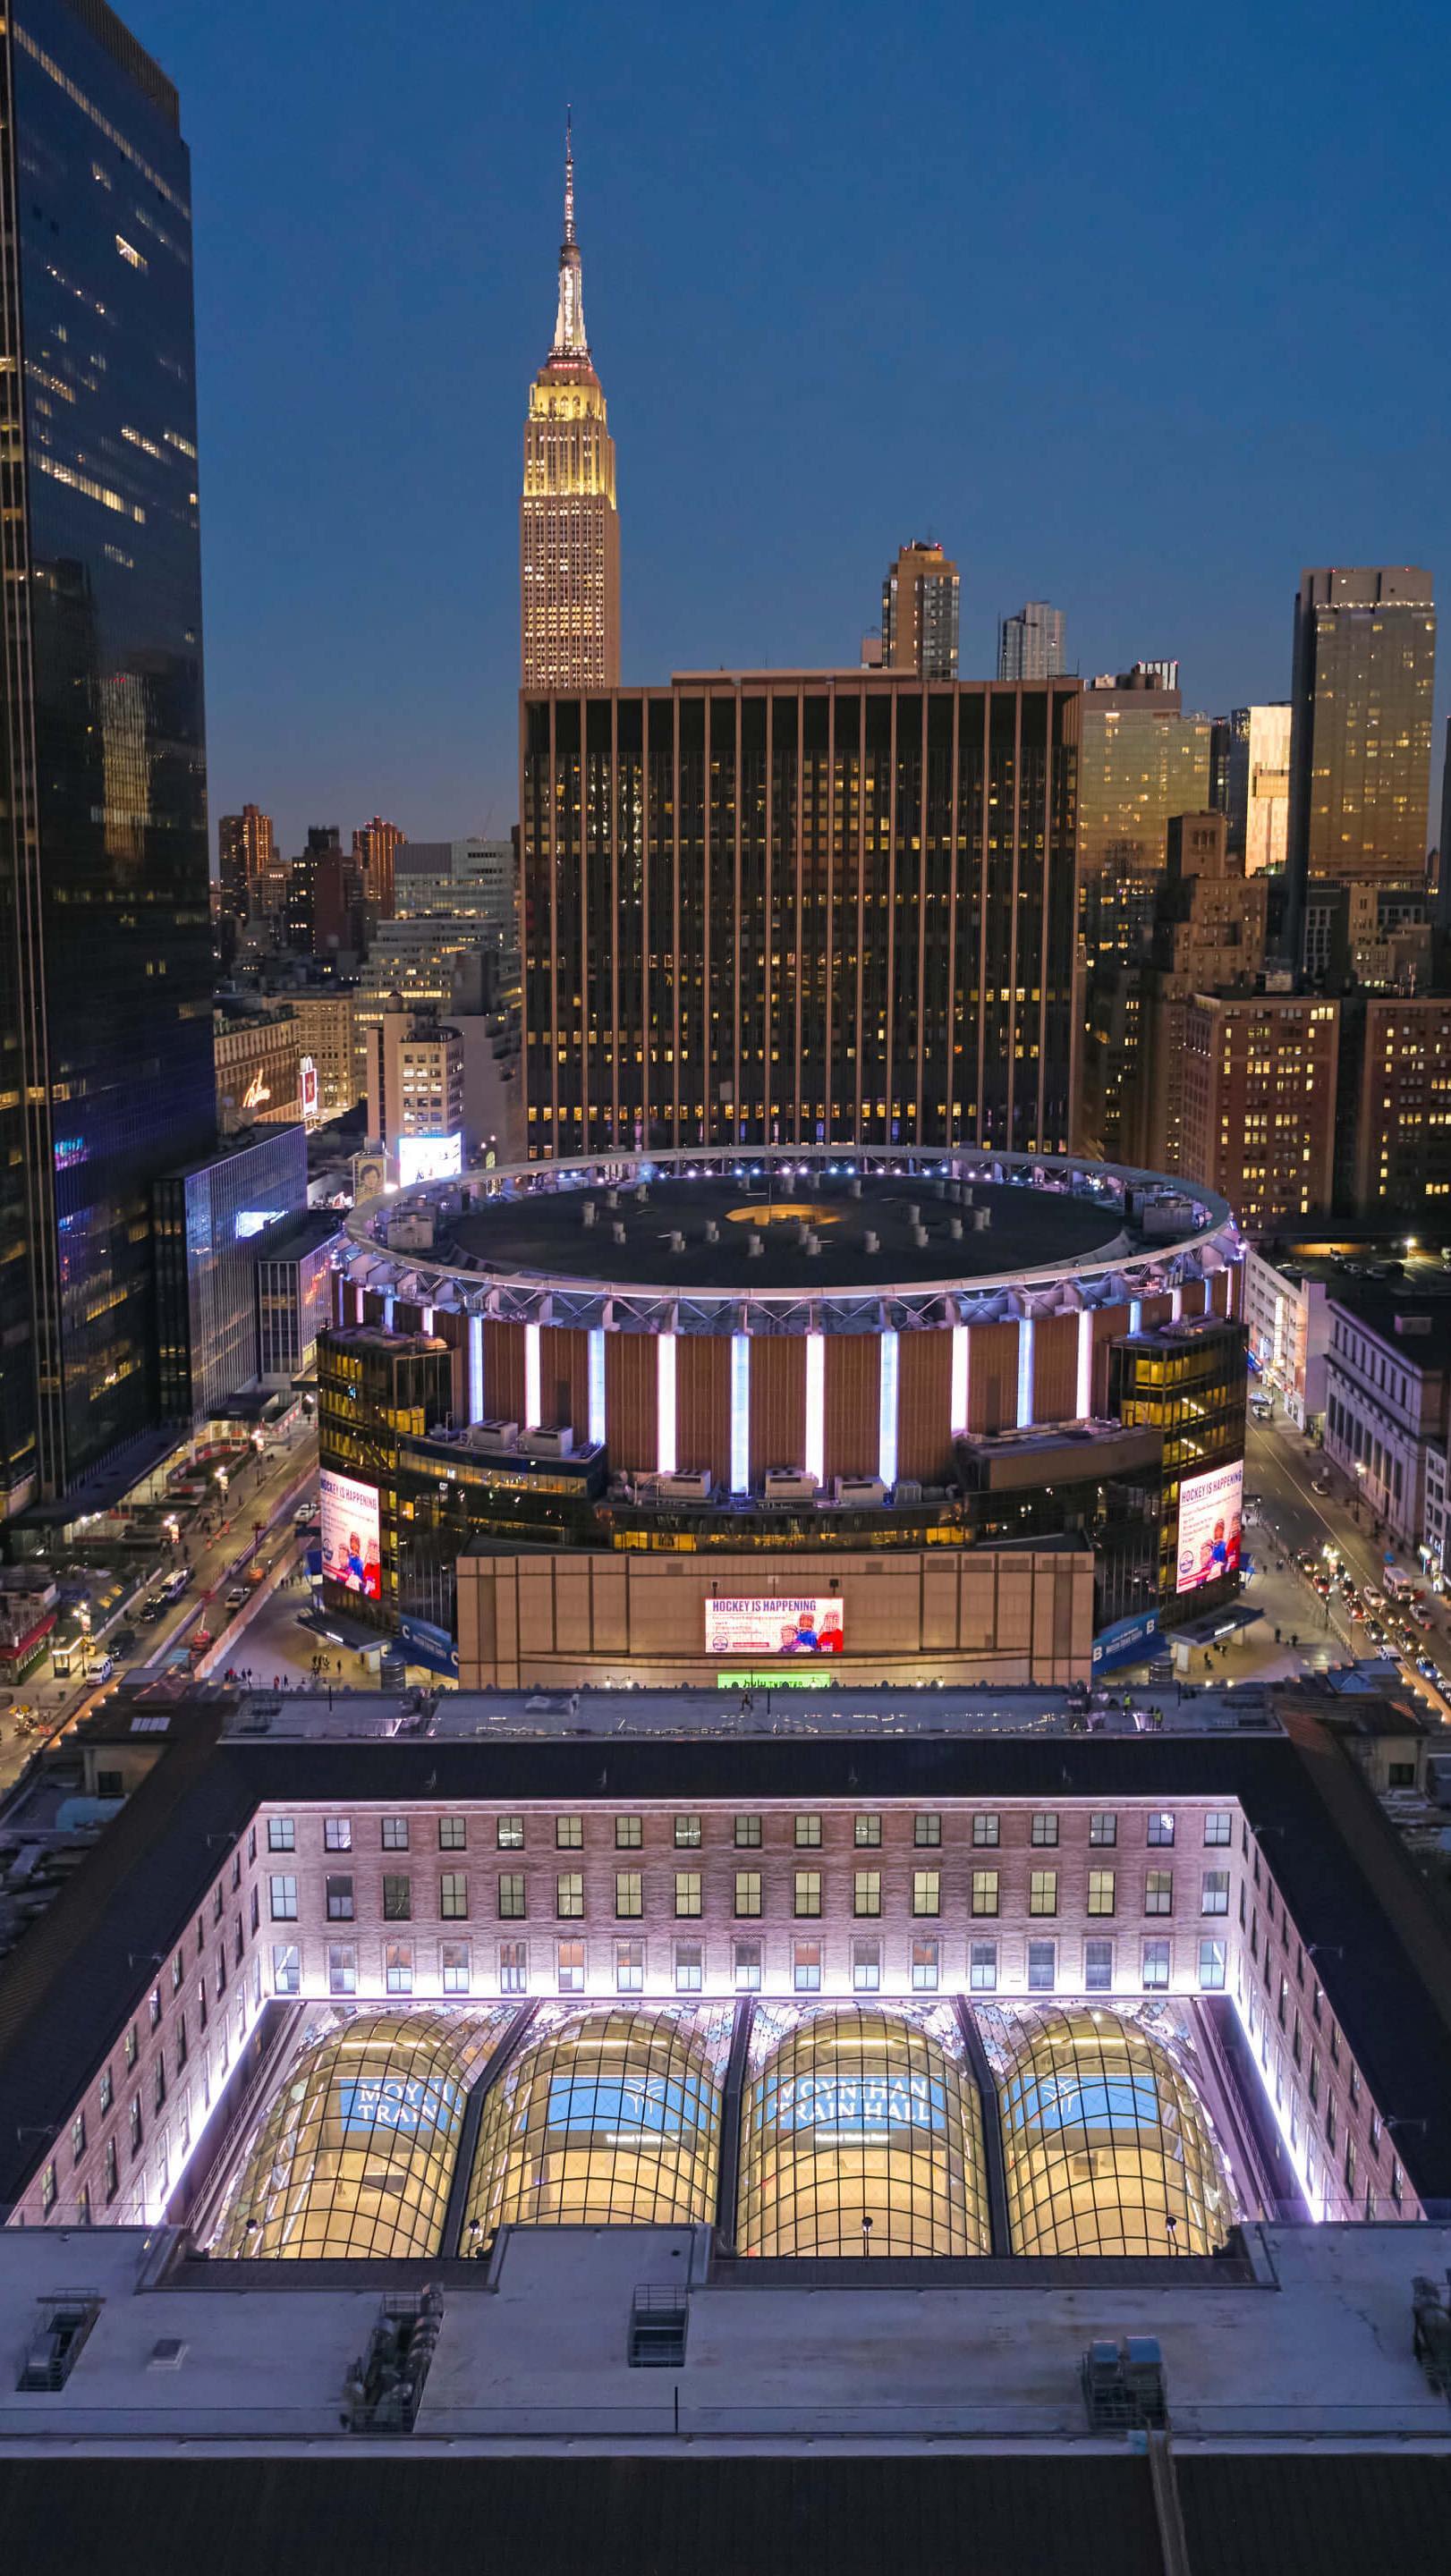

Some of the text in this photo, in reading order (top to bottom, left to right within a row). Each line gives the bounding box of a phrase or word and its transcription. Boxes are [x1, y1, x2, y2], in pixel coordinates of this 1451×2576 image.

[1181, 1470, 1242, 1503] HOCKEY IS HAPPENING
[345, 1487, 377, 1510] HAPPENING
[712, 1600, 816, 1612] HOCKEY IS HAPPENING
[402, 1624, 410, 1639] C
[1147, 1619, 1155, 1635] B
[451, 1651, 459, 1666] C
[1093, 1647, 1102, 1662] B
[743, 1679, 766, 1688] hulu
[780, 2080, 929, 2099] MOYNIHAN
[358, 2104, 437, 2123] TRAIN
[775, 2102, 930, 2121] TRAIN HALL
